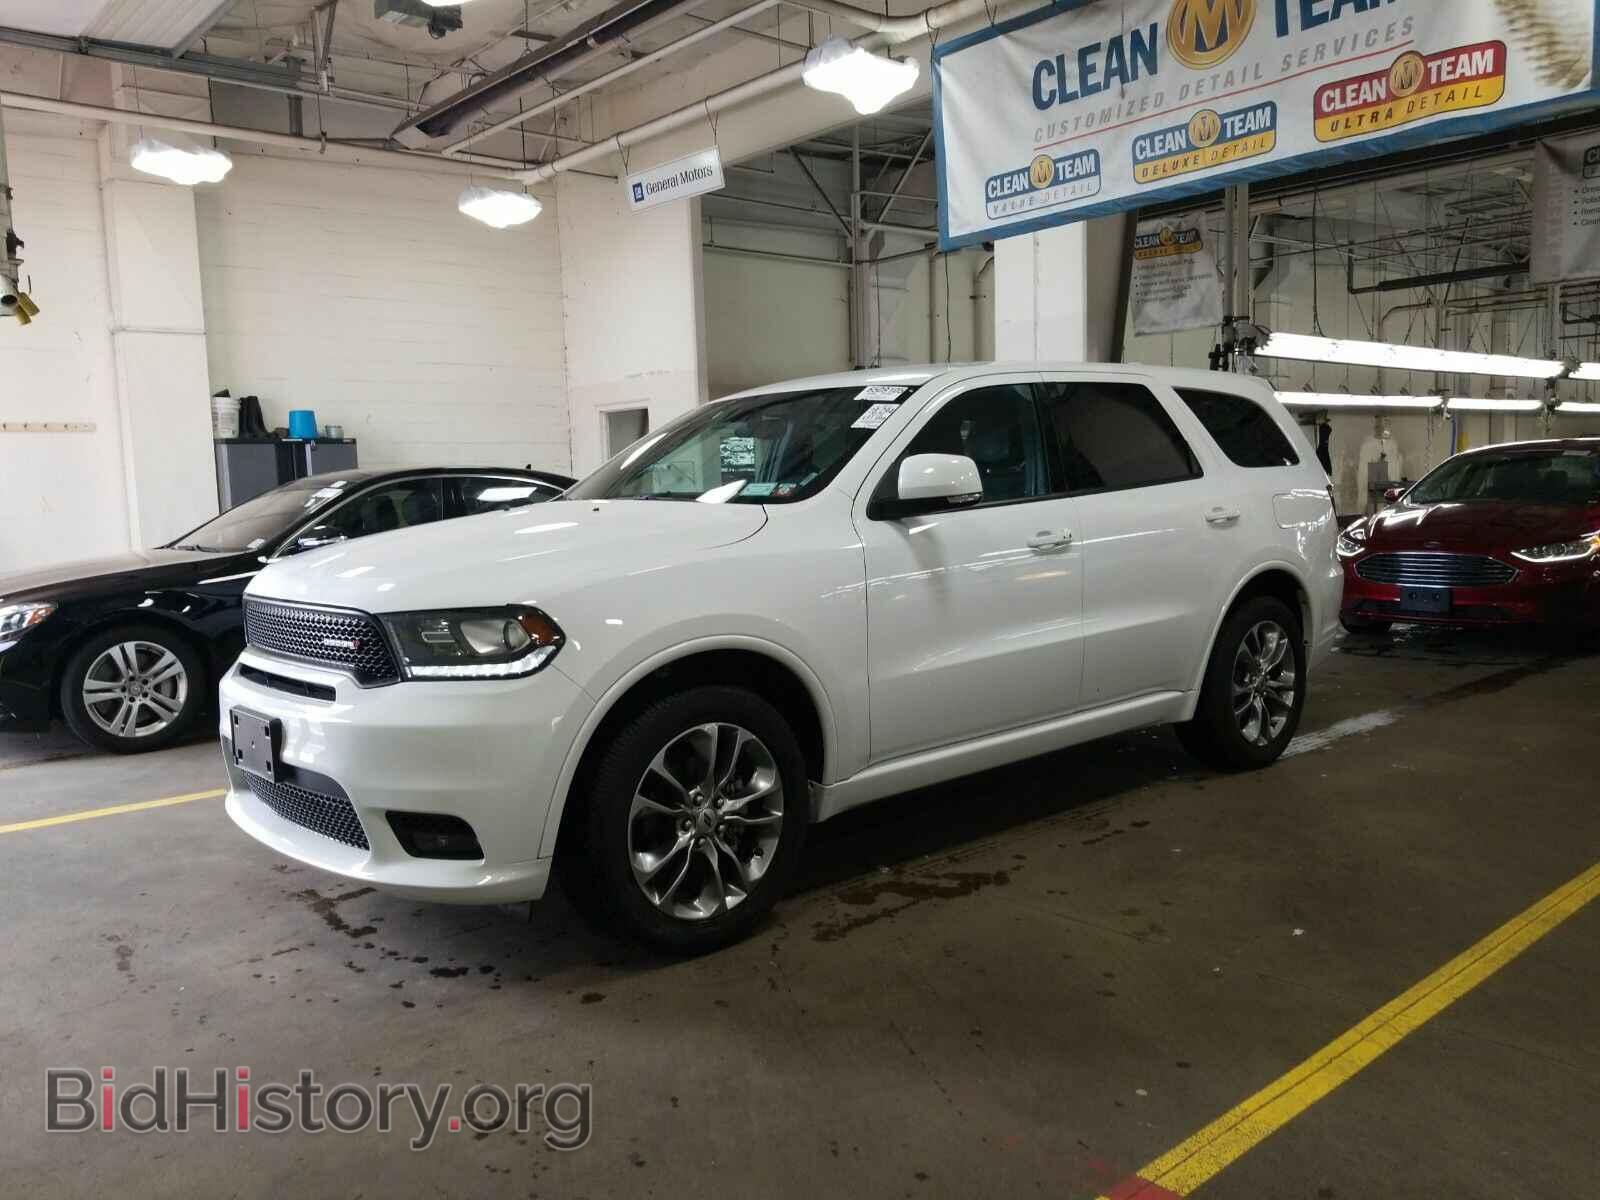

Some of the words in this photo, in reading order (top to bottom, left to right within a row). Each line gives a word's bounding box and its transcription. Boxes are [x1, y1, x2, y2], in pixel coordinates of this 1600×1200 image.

[1032, 22, 1158, 111] CLEAN
[1034, 91, 1165, 143] CUSTOMIZED
[1179, 62, 1264, 101] DETAIL
[1281, 15, 1414, 73] SERVICES
[1321, 77, 1386, 112] CLEAN
[1428, 49, 1494, 84] TEAM
[1330, 108, 1393, 132] ULTRA
[1406, 85, 1482, 114] DETAIL
[1135, 129, 1186, 160] CLEAN
[1223, 107, 1271, 138] TEAM
[646, 174, 680, 195] General
[680, 166, 713, 185] Motors
[987, 171, 1029, 199] CLEAN
[1056, 153, 1096, 181] TEAM
[1141, 154, 1200, 178] DELUXE
[1210, 137, 1266, 161] DETAIL
[993, 195, 1034, 214] VALUE
